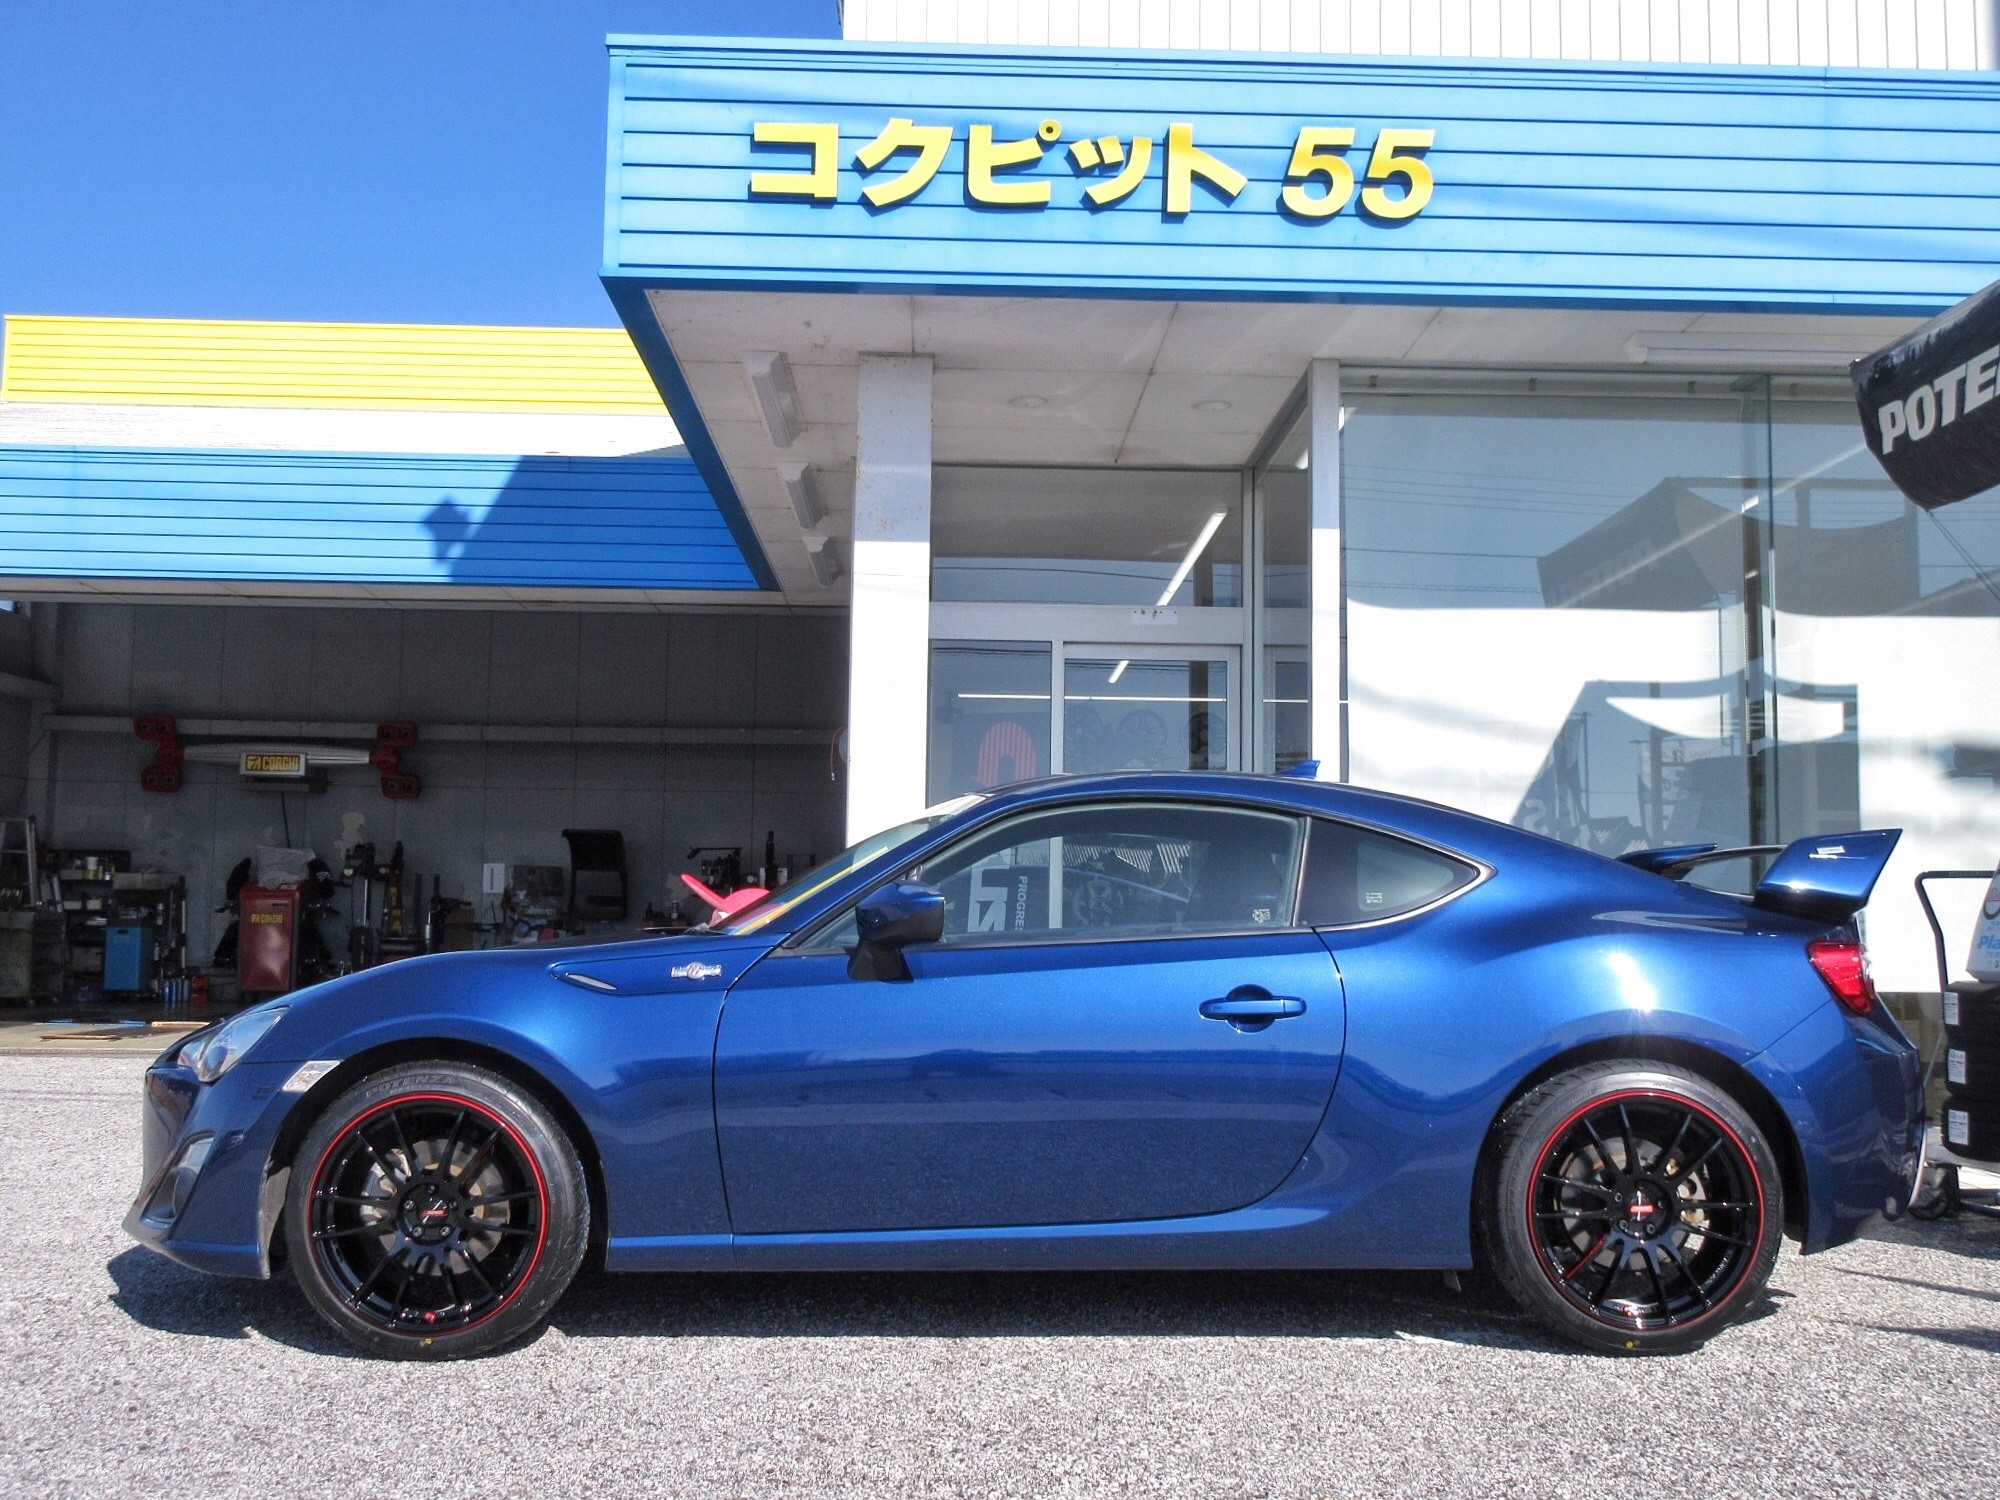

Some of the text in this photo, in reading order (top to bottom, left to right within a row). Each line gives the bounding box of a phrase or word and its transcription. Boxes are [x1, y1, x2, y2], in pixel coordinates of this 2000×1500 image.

[750, 117, 1435, 219] コクピット 55
[1878, 344, 2000, 455] POTE
[263, 755, 298, 772] CORGHI
